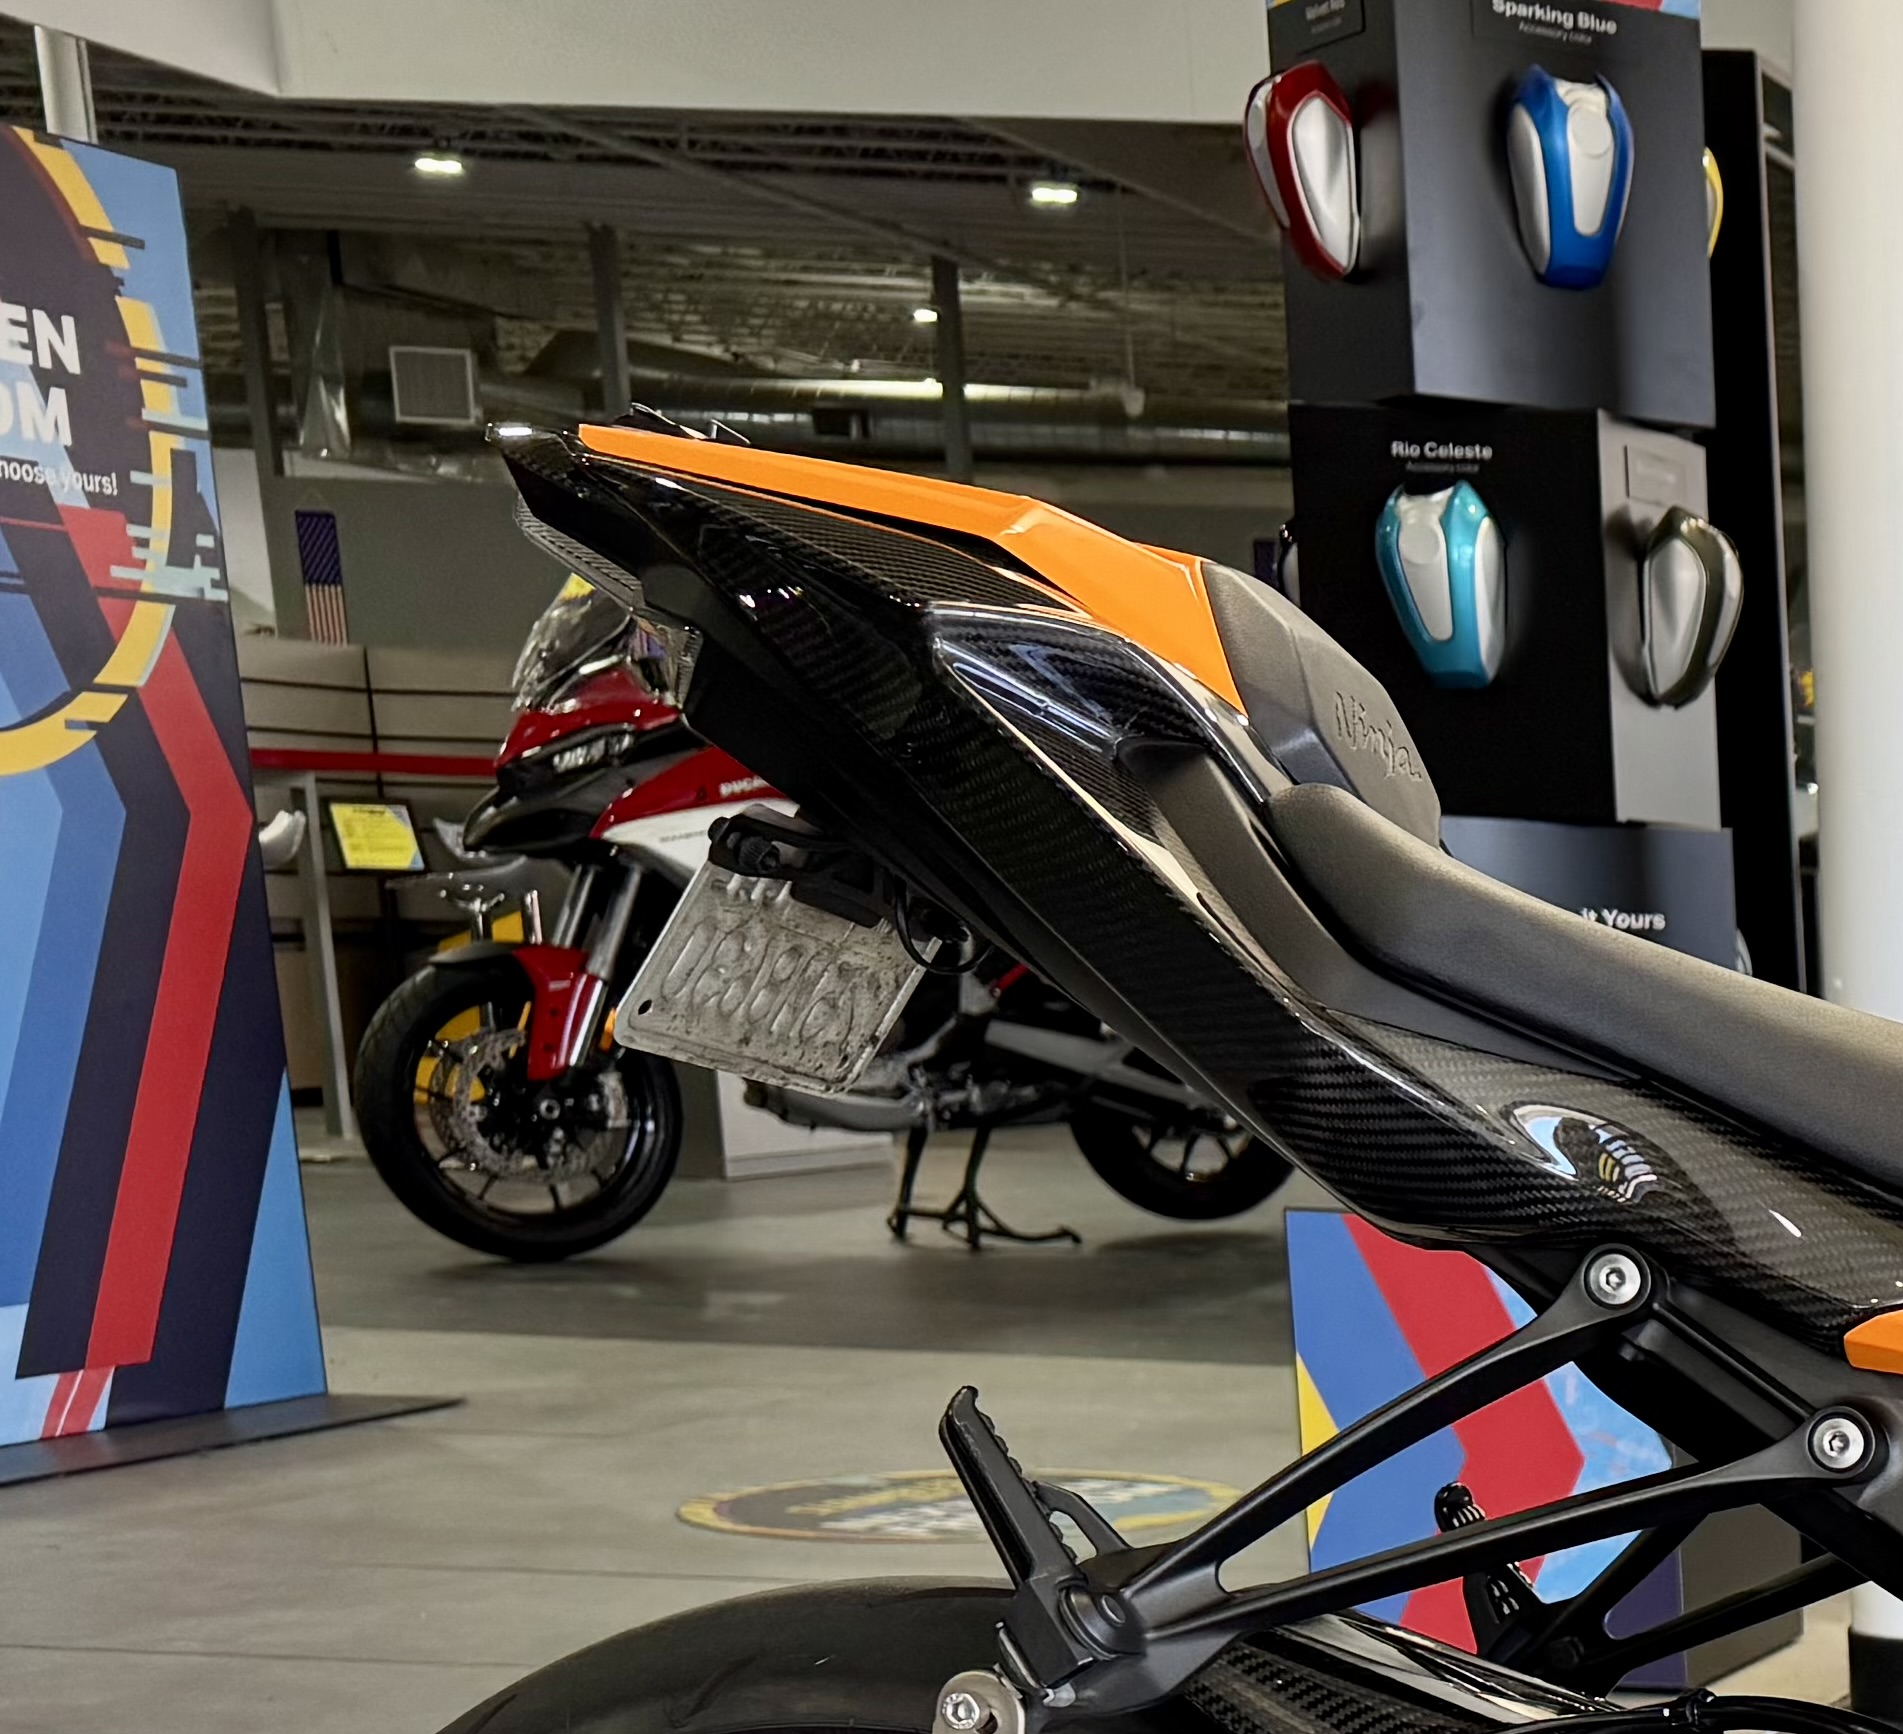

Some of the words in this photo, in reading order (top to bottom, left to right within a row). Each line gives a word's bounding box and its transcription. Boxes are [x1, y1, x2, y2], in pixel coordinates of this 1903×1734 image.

[1492, 0, 1574, 29] Sparking
[1577, 11, 1618, 35] Blue
[1391, 440, 1421, 459] Rio
[1423, 441, 1493, 461] Celeste
[62, 467, 119, 496] yours!
[1334, 690, 1424, 782] Ninja
[1601, 907, 1667, 931] Yours
